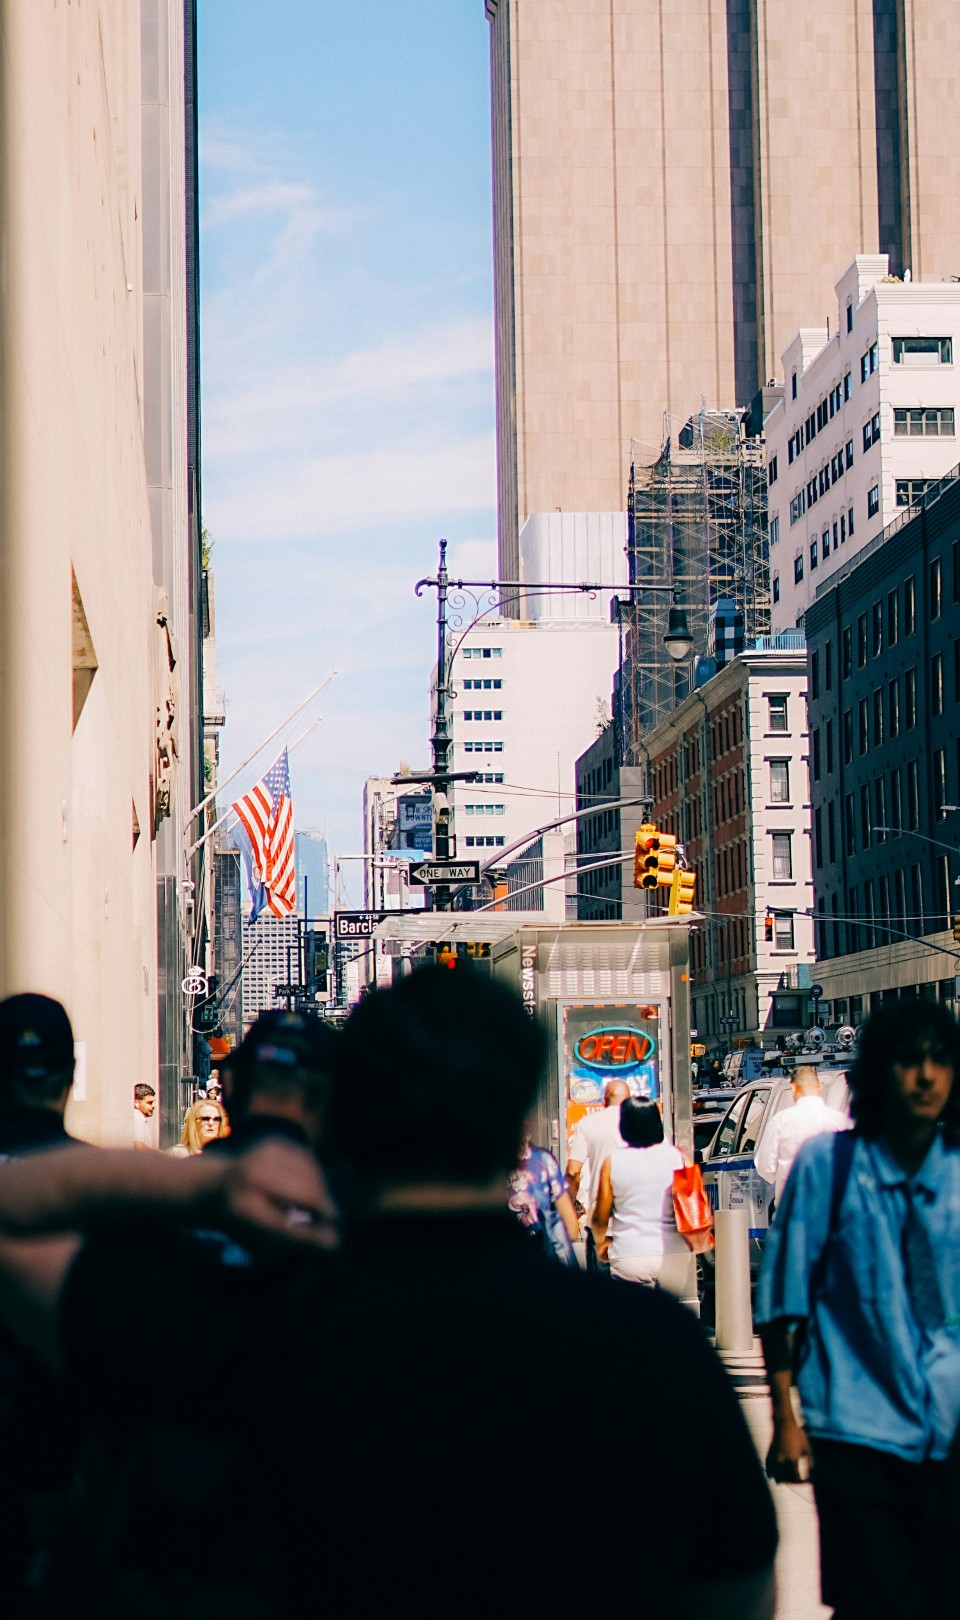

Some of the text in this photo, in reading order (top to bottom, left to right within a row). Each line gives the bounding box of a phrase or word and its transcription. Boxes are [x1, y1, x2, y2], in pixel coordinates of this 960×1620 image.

[419, 867, 471, 879] ONE WAY
[580, 1036, 649, 1060] OPEN
